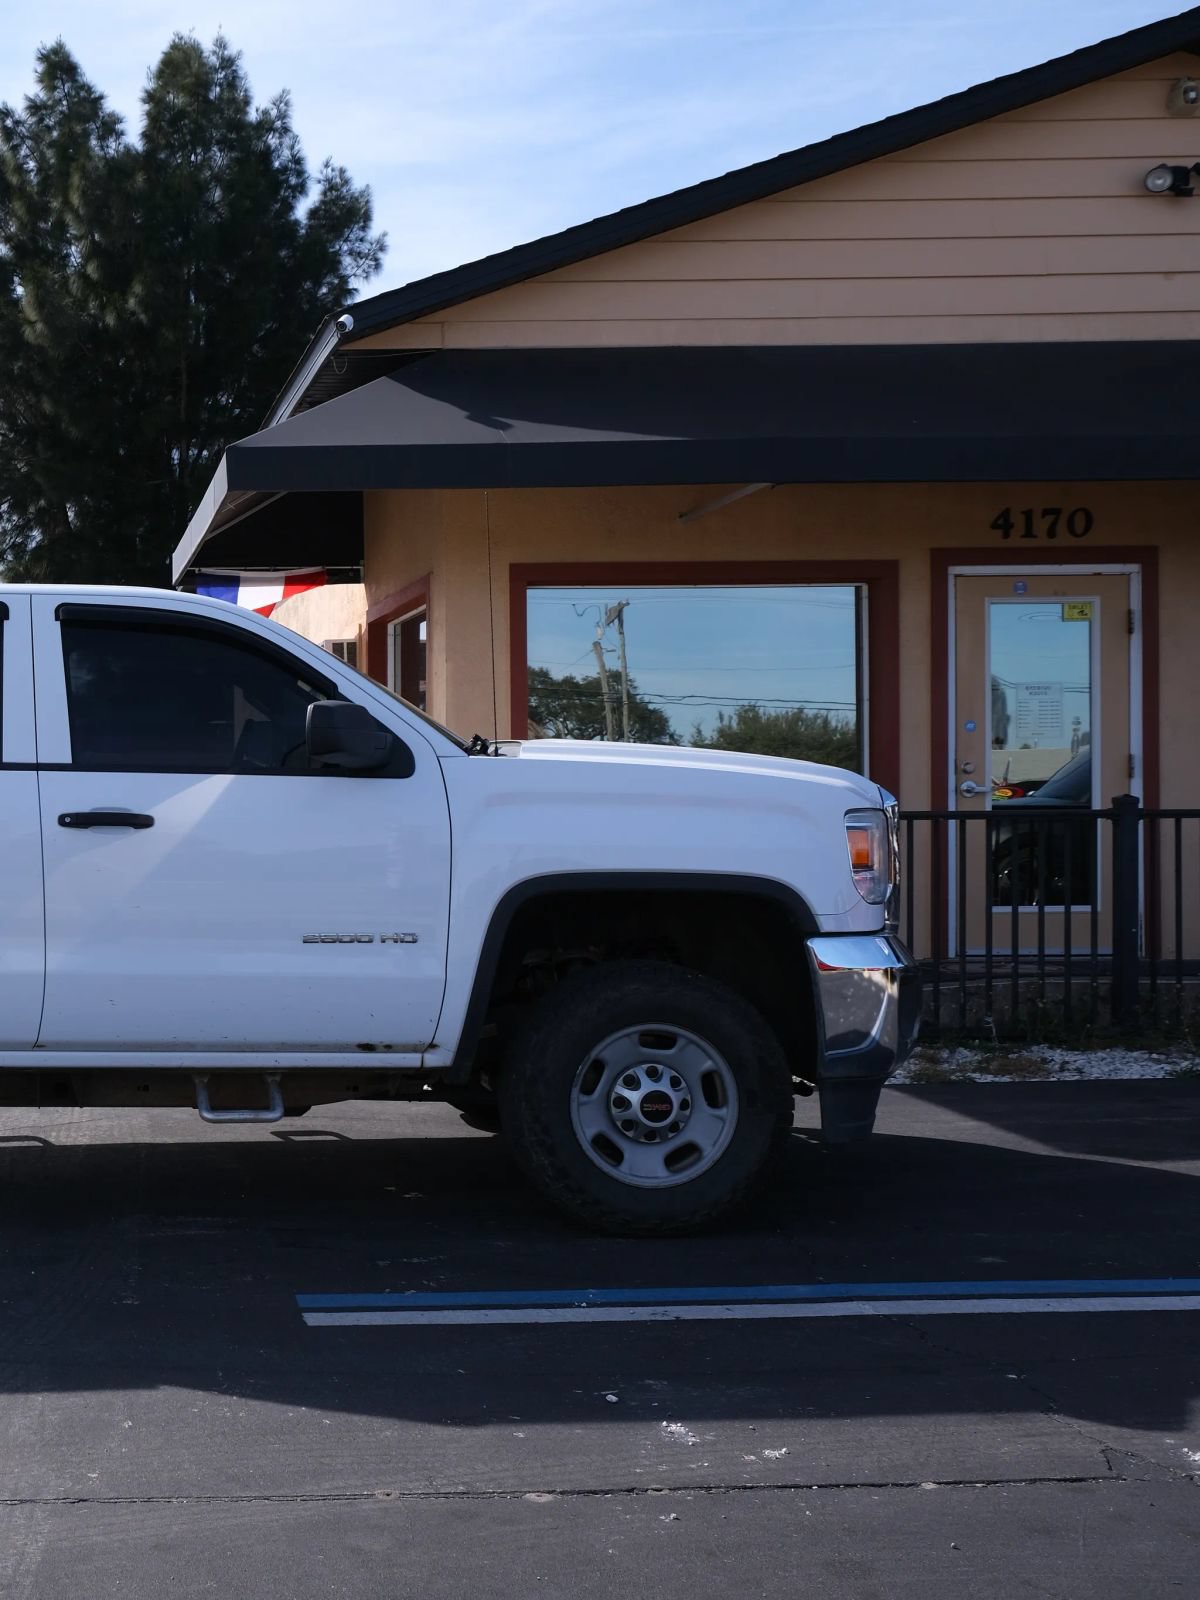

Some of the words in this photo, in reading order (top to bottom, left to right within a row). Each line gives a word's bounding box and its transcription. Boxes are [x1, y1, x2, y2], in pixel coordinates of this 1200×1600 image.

[990, 507, 1094, 539] 4170
[302, 932, 374, 944] 2500
[380, 932, 418, 944] HD
[642, 1103, 671, 1111] GMC
